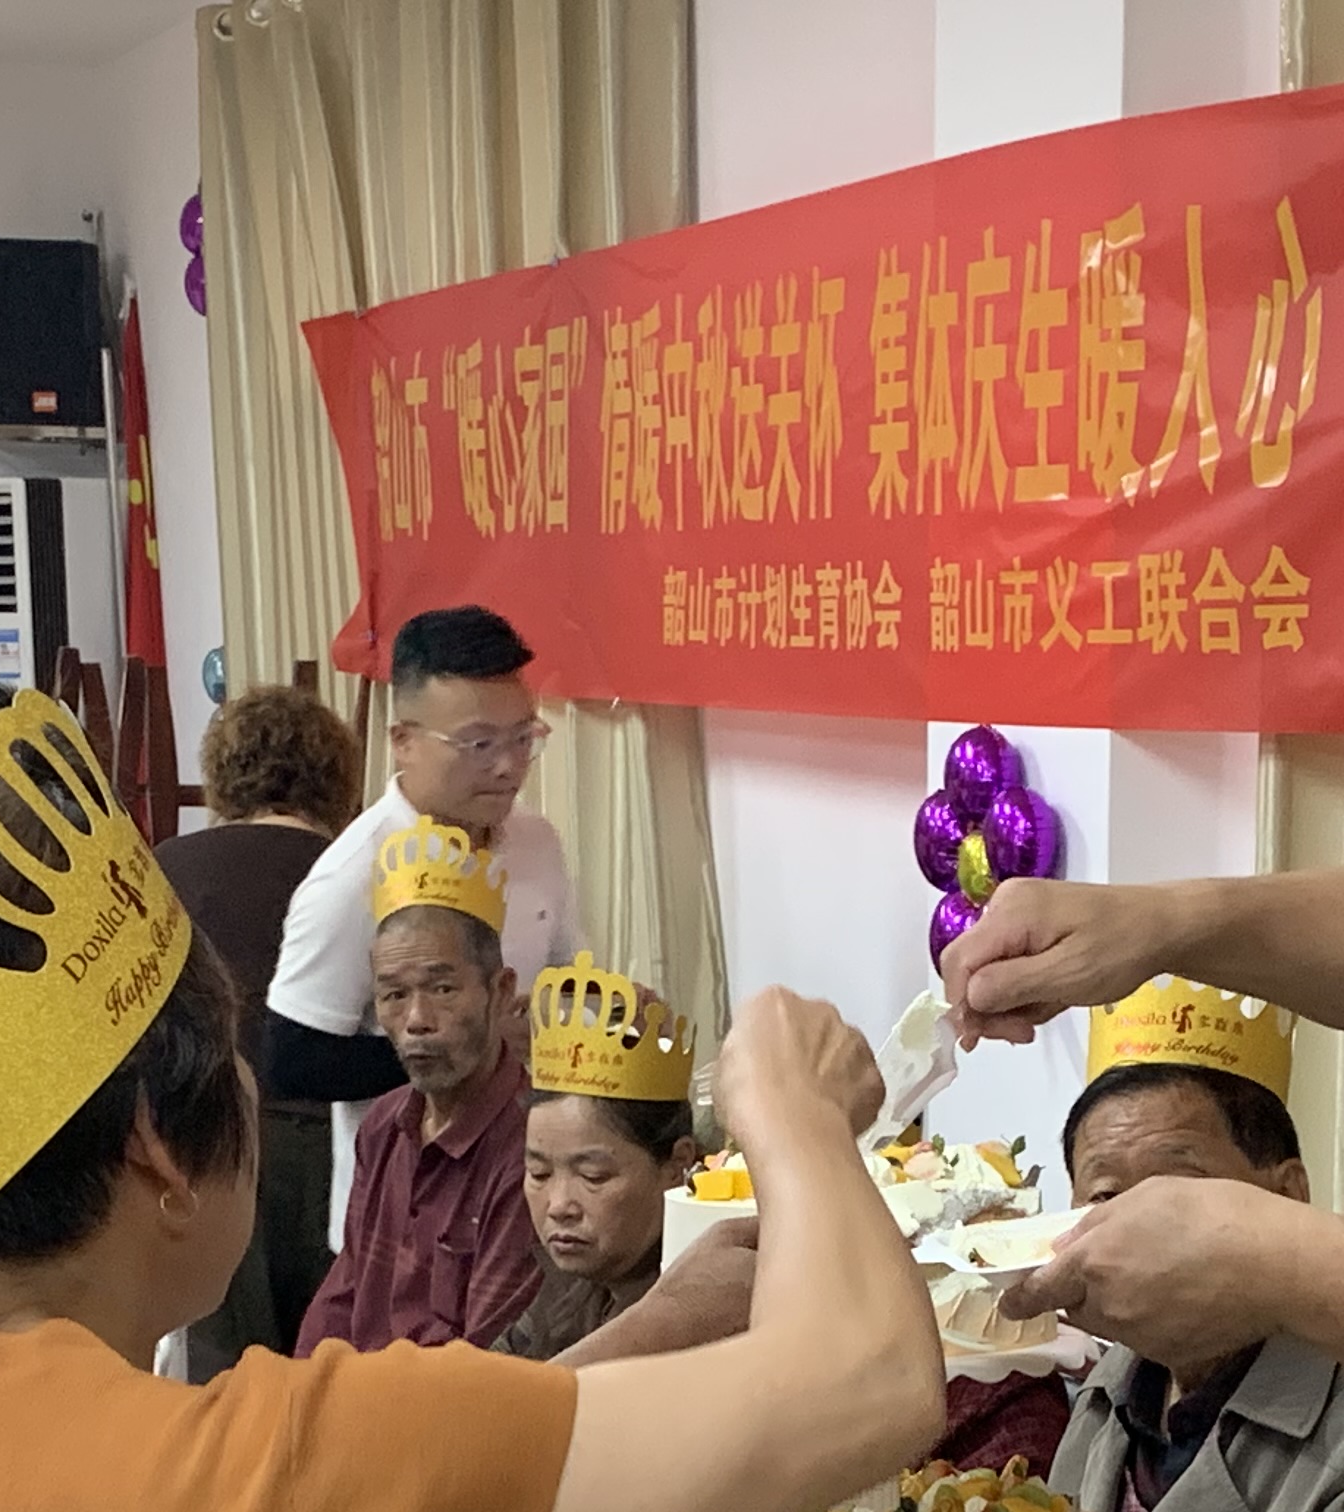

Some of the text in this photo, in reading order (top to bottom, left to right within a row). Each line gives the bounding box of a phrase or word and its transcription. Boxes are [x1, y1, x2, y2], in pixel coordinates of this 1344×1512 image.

[868, 194, 1323, 519] 集体庆生暖人心
[662, 545, 1312, 655] 韶山市计划生育协会 韶山市义工联合会
[60, 905, 127, 985] Doxila
[105, 952, 162, 1027] Happy
